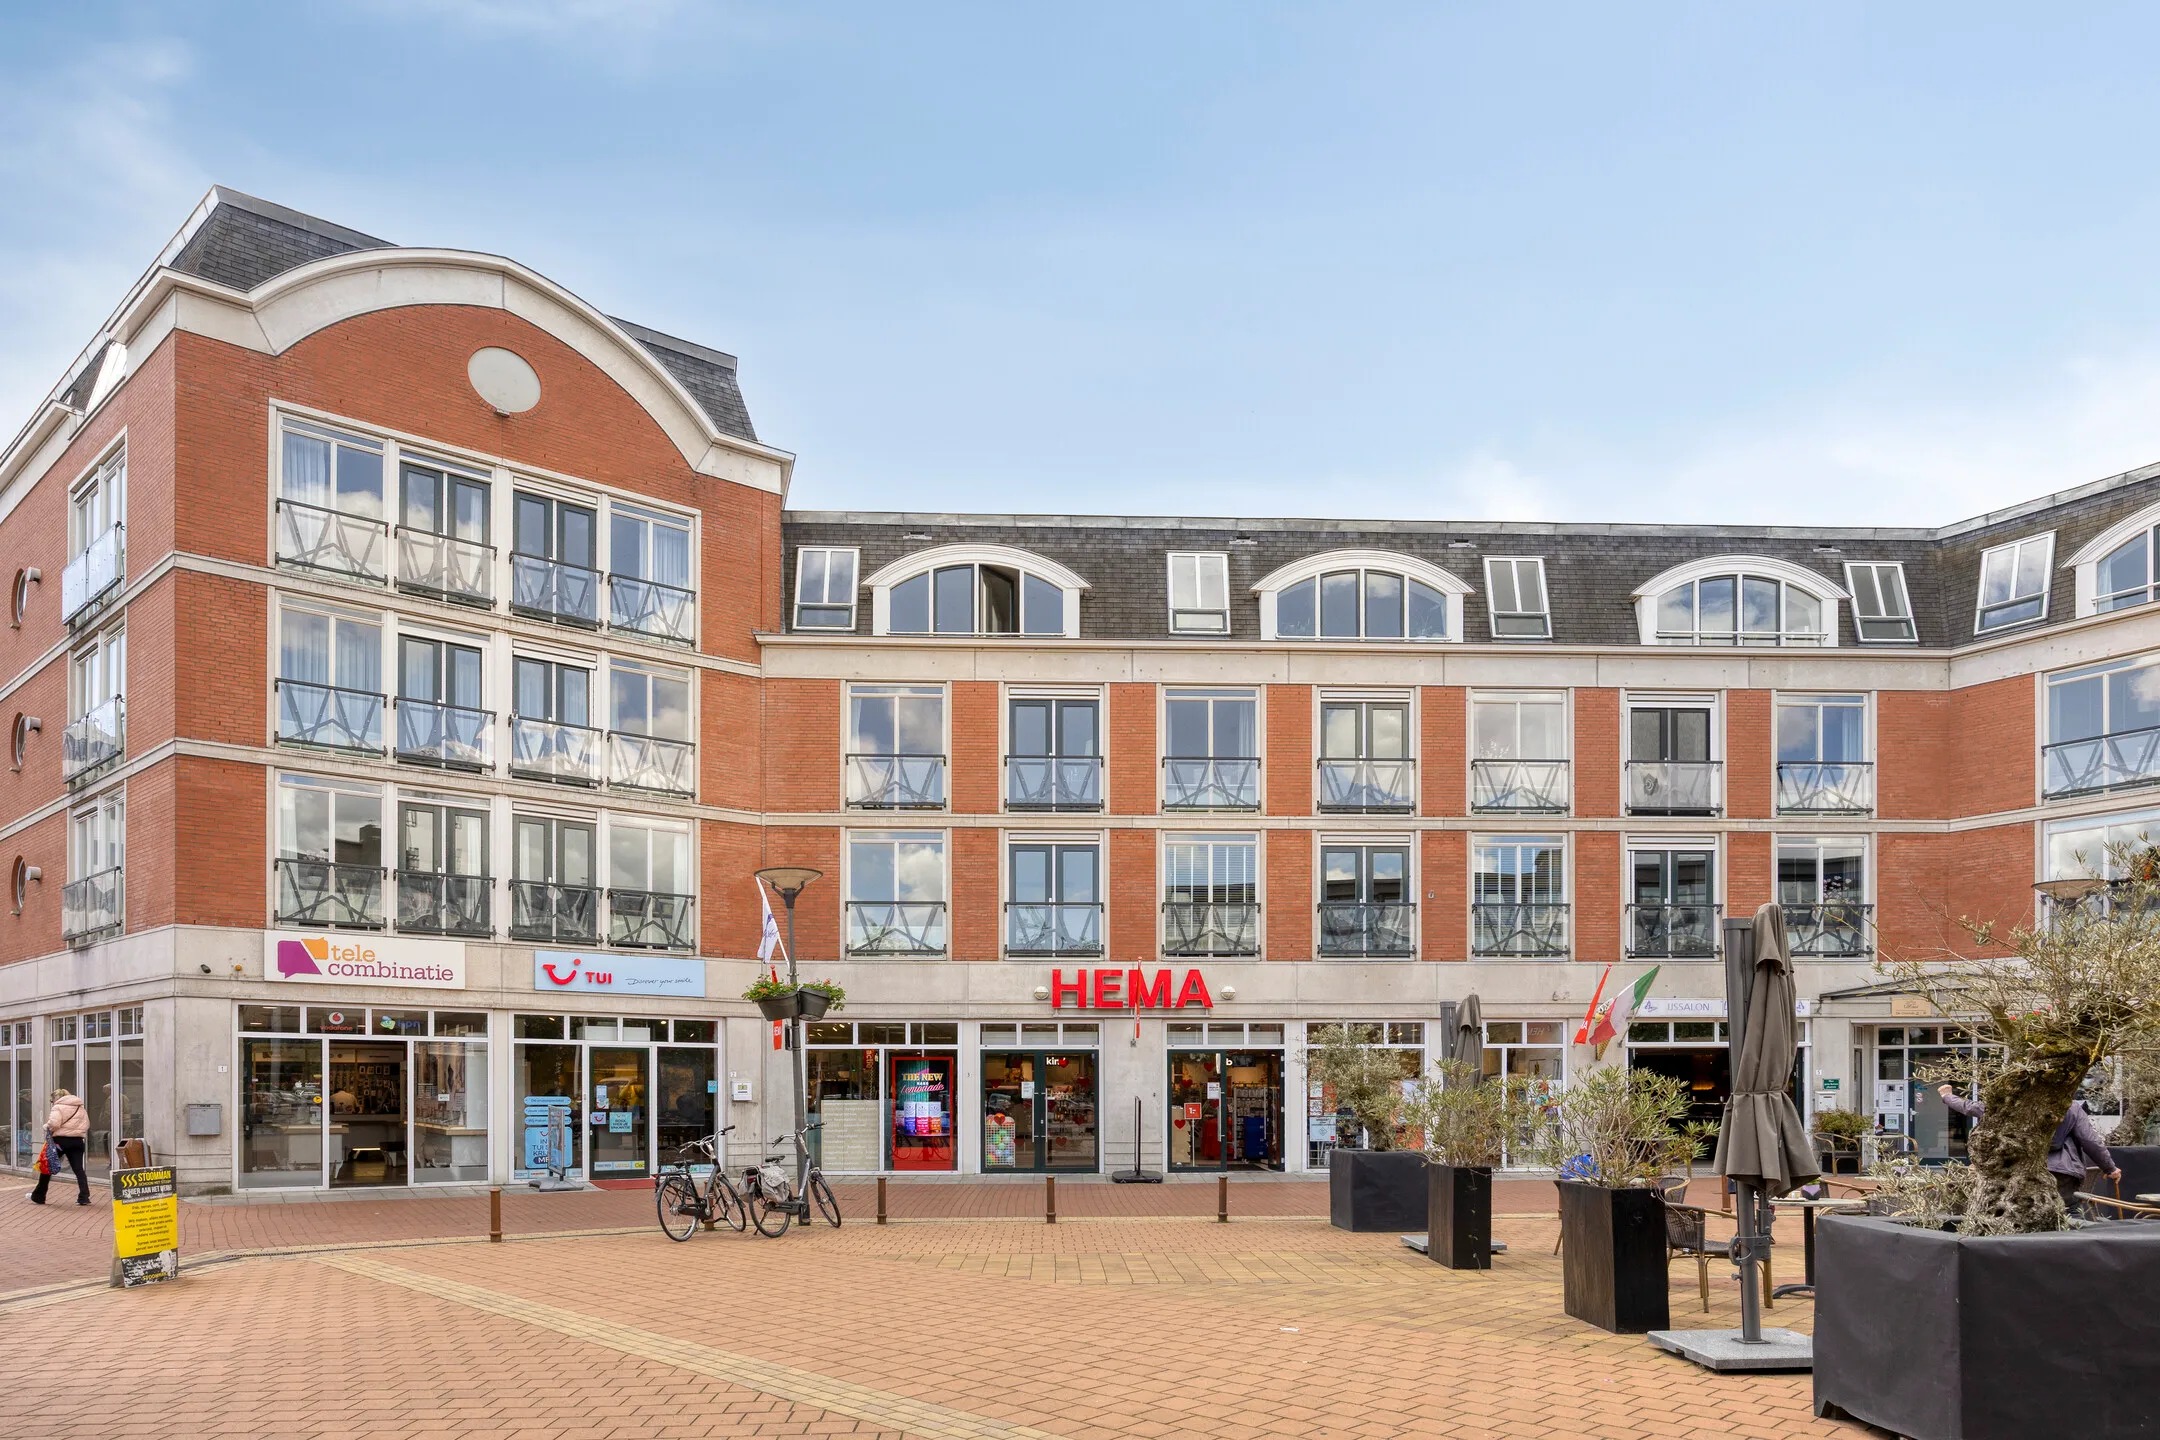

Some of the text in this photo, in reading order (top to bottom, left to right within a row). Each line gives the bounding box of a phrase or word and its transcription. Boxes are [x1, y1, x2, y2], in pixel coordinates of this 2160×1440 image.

[331, 944, 375, 962] tele
[328, 961, 454, 981] combinatie
[585, 971, 612, 984] TUI
[625, 977, 658, 986] Discover
[658, 979, 674, 987] your
[1052, 969, 1214, 1009] HEMA
[397, 1018, 421, 1029] kpn
[902, 1073, 944, 1081] THE NEW
[901, 1081, 945, 1094] Lemonade
[138, 1170, 171, 1182] STOOMMAN
[141, 1186, 151, 1194] AAN
